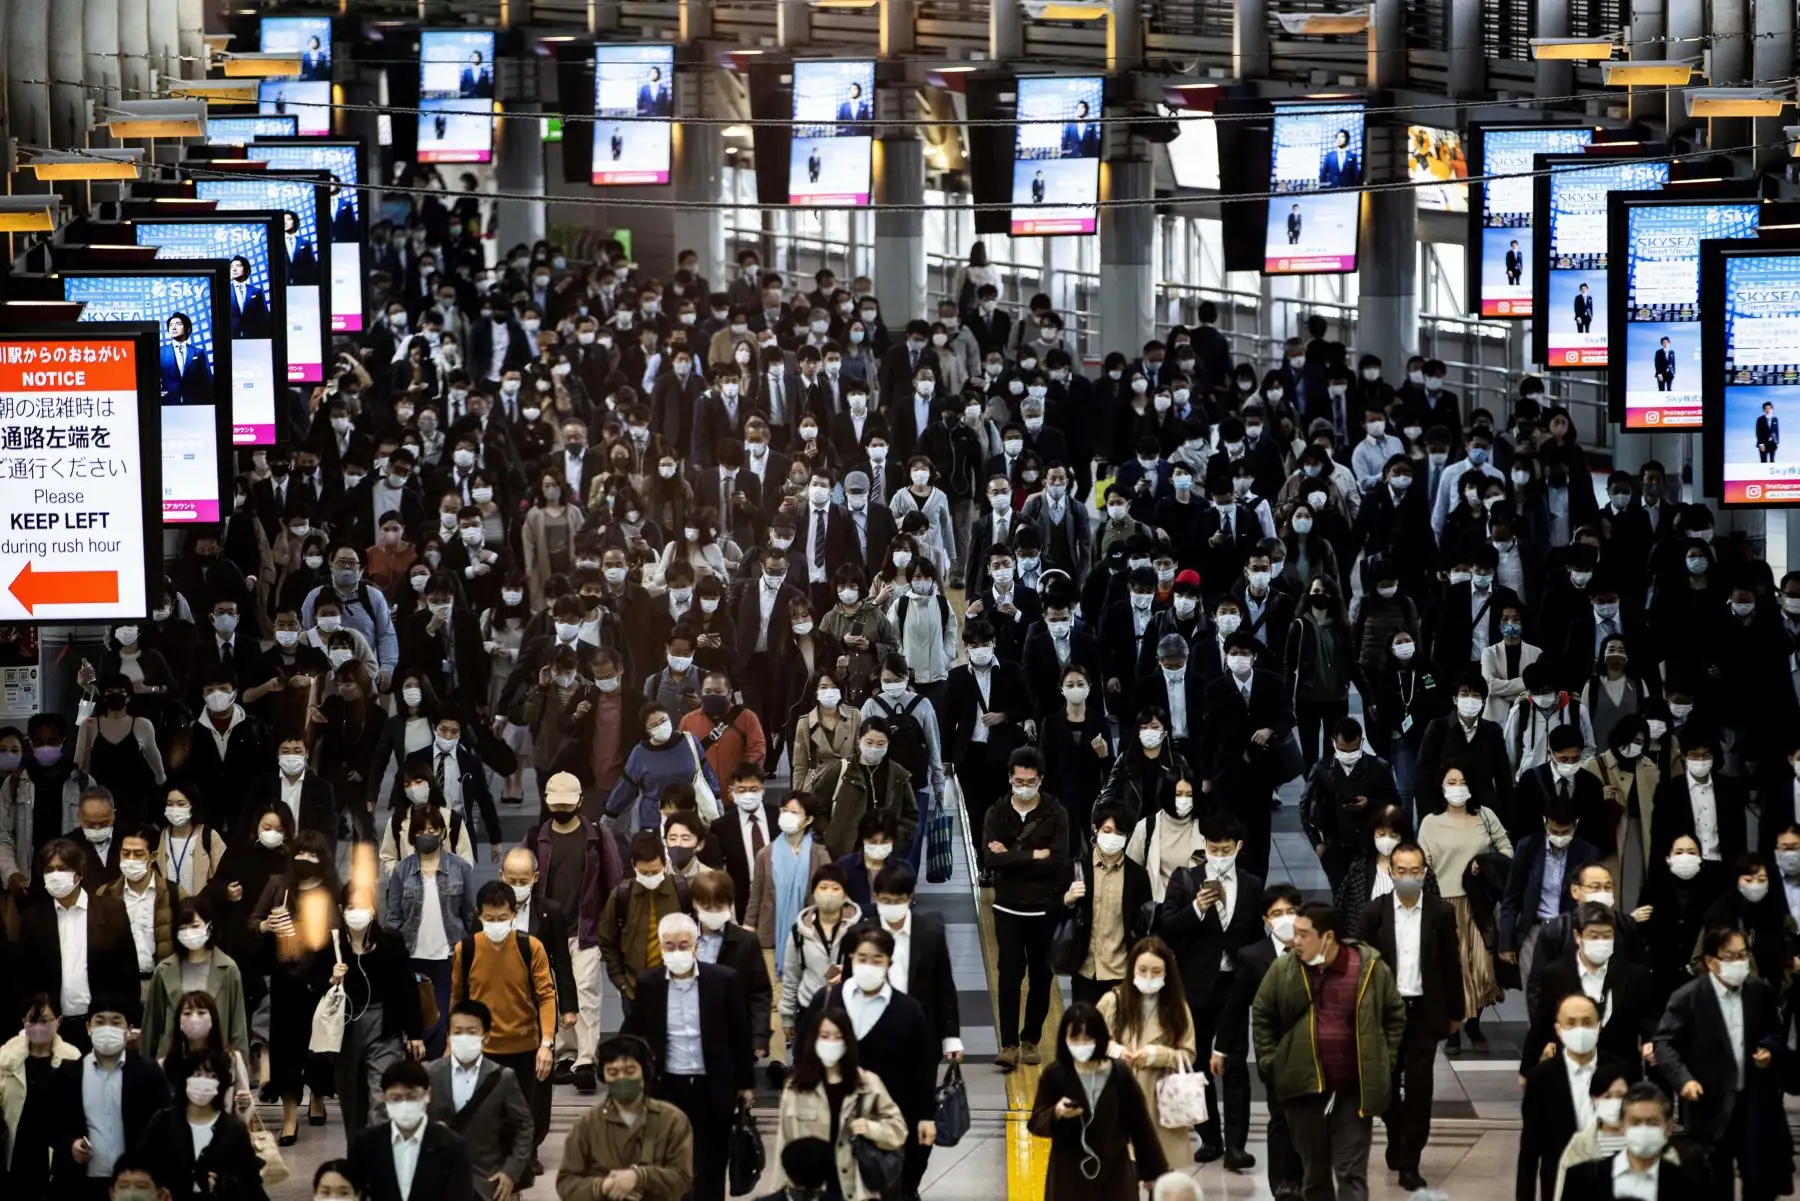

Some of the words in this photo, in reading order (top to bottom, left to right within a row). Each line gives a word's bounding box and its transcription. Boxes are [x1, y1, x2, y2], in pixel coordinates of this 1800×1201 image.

[327, 151, 352, 163] Sky
[1635, 167, 1665, 182] Sky
[283, 184, 312, 198] Sky
[1723, 209, 1755, 226] Sky
[232, 227, 264, 242] Sky
[1638, 237, 1696, 247] SKYSEA
[169, 281, 206, 298] Sky
[22, 371, 86, 386] NOTICE
[0, 397, 115, 419] 朝の混雑時は
[1, 425, 111, 450] 通路左端を
[34, 489, 84, 504] Please
[11, 513, 60, 530] KEEP
[65, 512, 110, 529] LEFT
[1, 539, 47, 557] during
[52, 539, 84, 553] rush
[89, 538, 121, 552] hour
